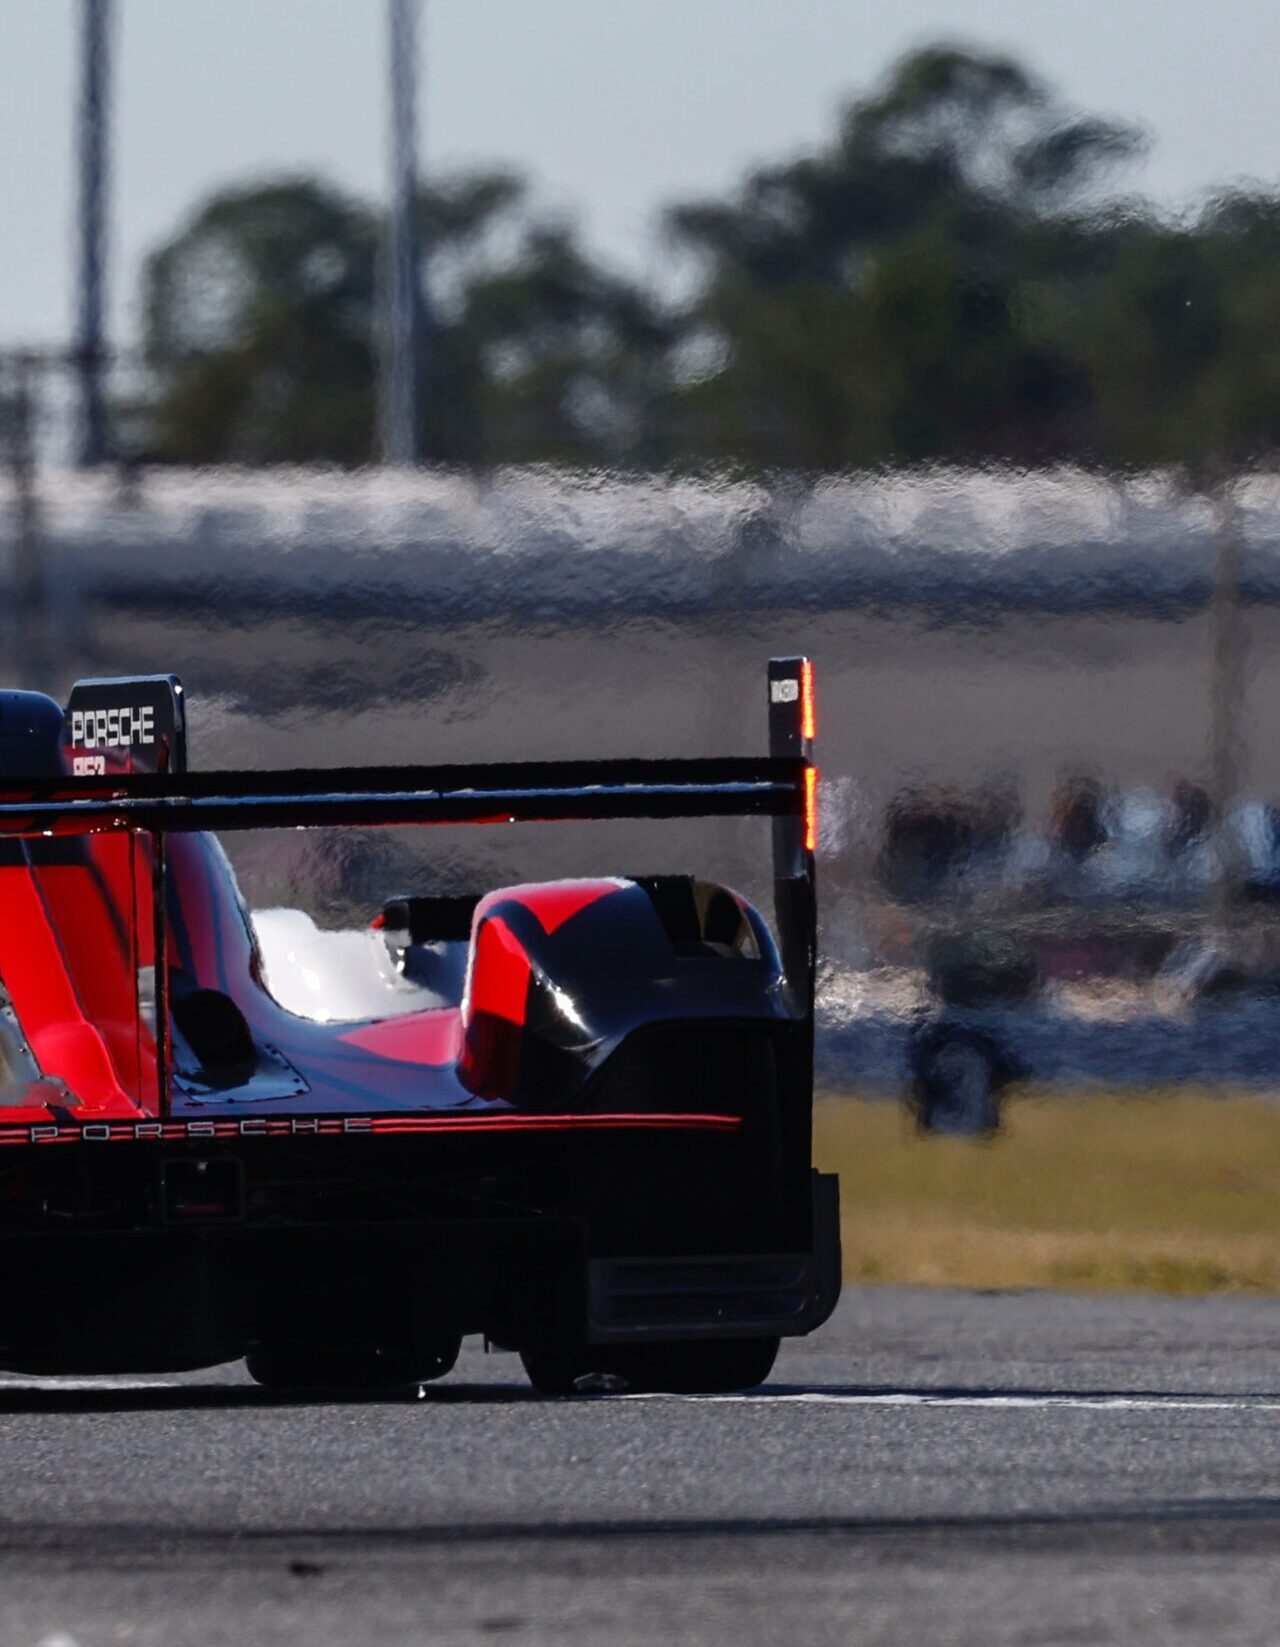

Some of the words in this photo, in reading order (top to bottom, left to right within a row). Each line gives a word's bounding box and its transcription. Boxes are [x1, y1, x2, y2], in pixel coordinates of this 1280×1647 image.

[72, 706, 155, 749] PORSCHE
[73, 756, 106, 777] 963
[30, 1117, 373, 1143] PORSCHE
